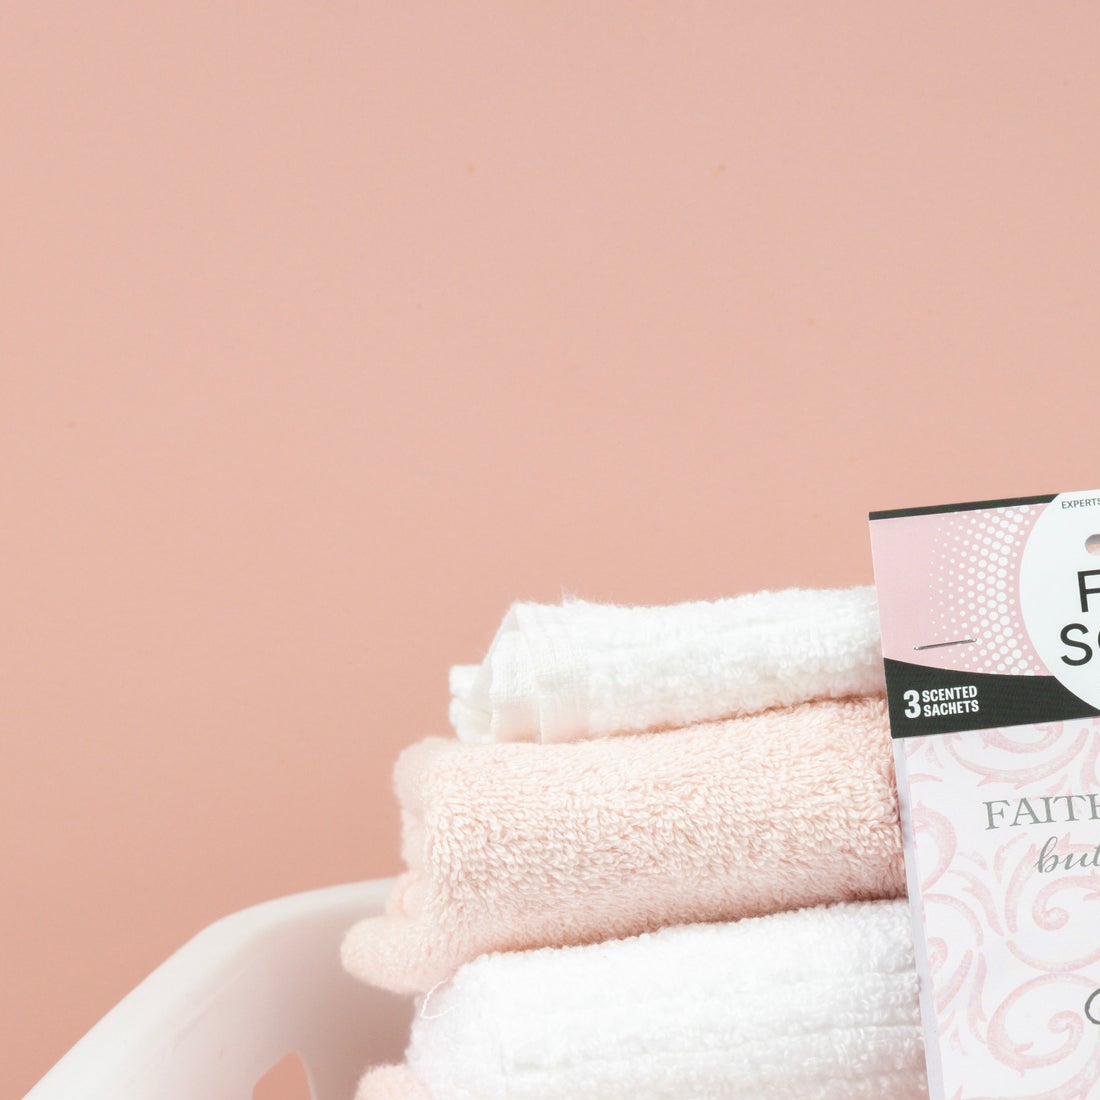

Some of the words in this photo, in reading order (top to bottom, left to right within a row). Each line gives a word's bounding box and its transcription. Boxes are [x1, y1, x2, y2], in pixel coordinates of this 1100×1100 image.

[922, 685, 978, 703] SCENTED
[903, 689, 921, 719] 3
[923, 699, 980, 717] SACHETS
